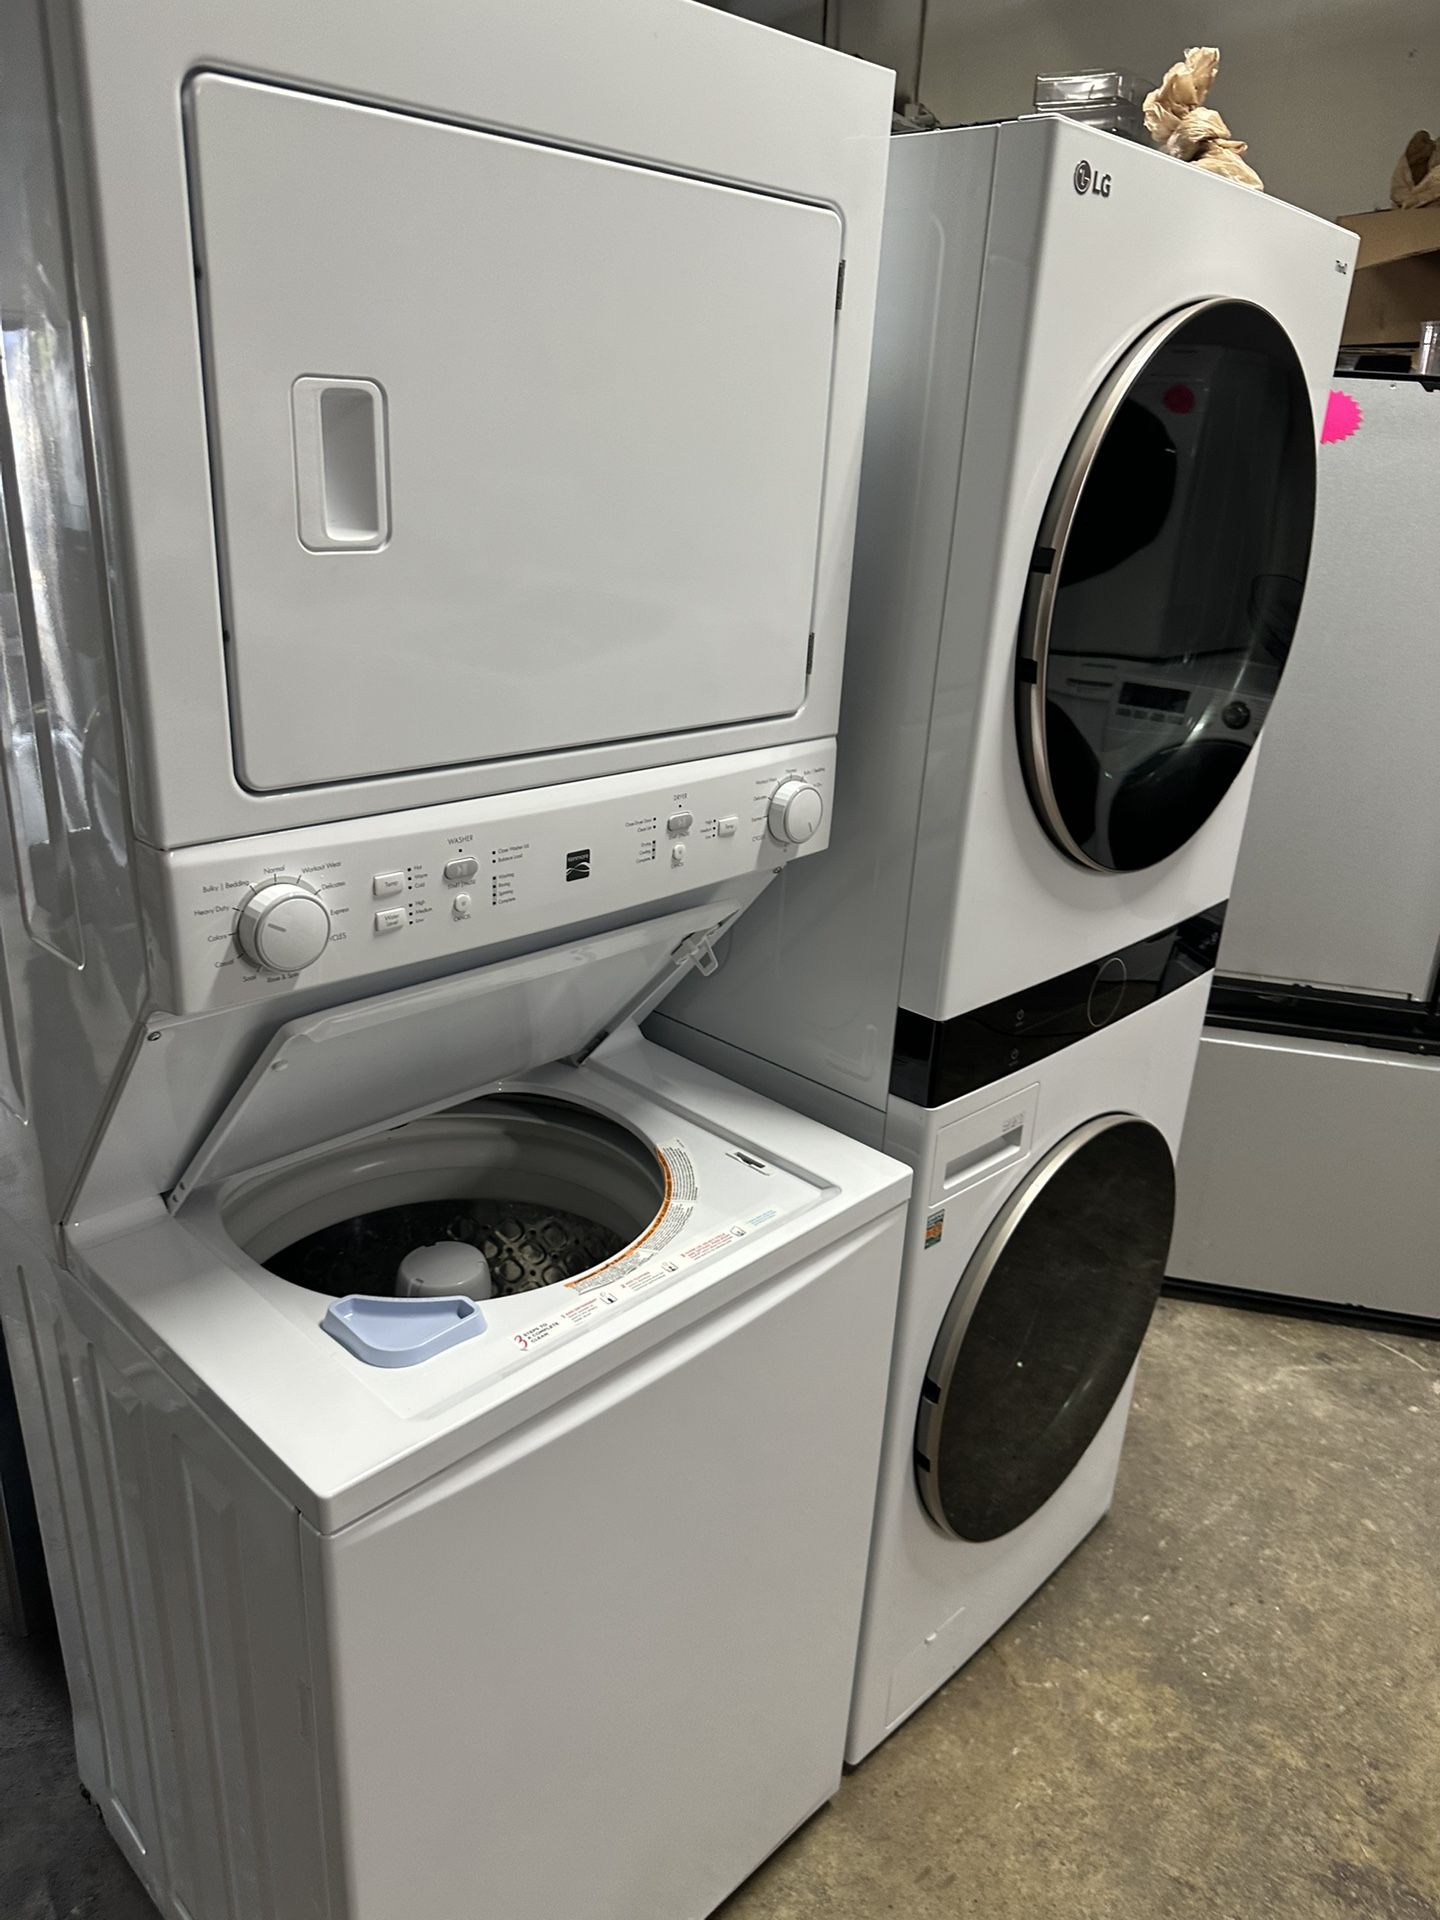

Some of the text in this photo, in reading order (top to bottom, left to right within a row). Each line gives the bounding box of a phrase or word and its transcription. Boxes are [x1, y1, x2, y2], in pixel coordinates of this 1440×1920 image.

[1092, 170, 1112, 198] LG
[447, 835, 473, 845] WASHER
[263, 865, 286, 874] Normal
[301, 861, 342, 874] Workout Wear
[202, 885, 219, 893] Bulky
[225, 879, 250, 889] Bedding
[321, 881, 346, 890] Delicates
[194, 904, 229, 917] Heavy Duty
[330, 907, 349, 916] Express
[207, 934, 227, 943] Colors
[513, 1334, 528, 1349] 3
